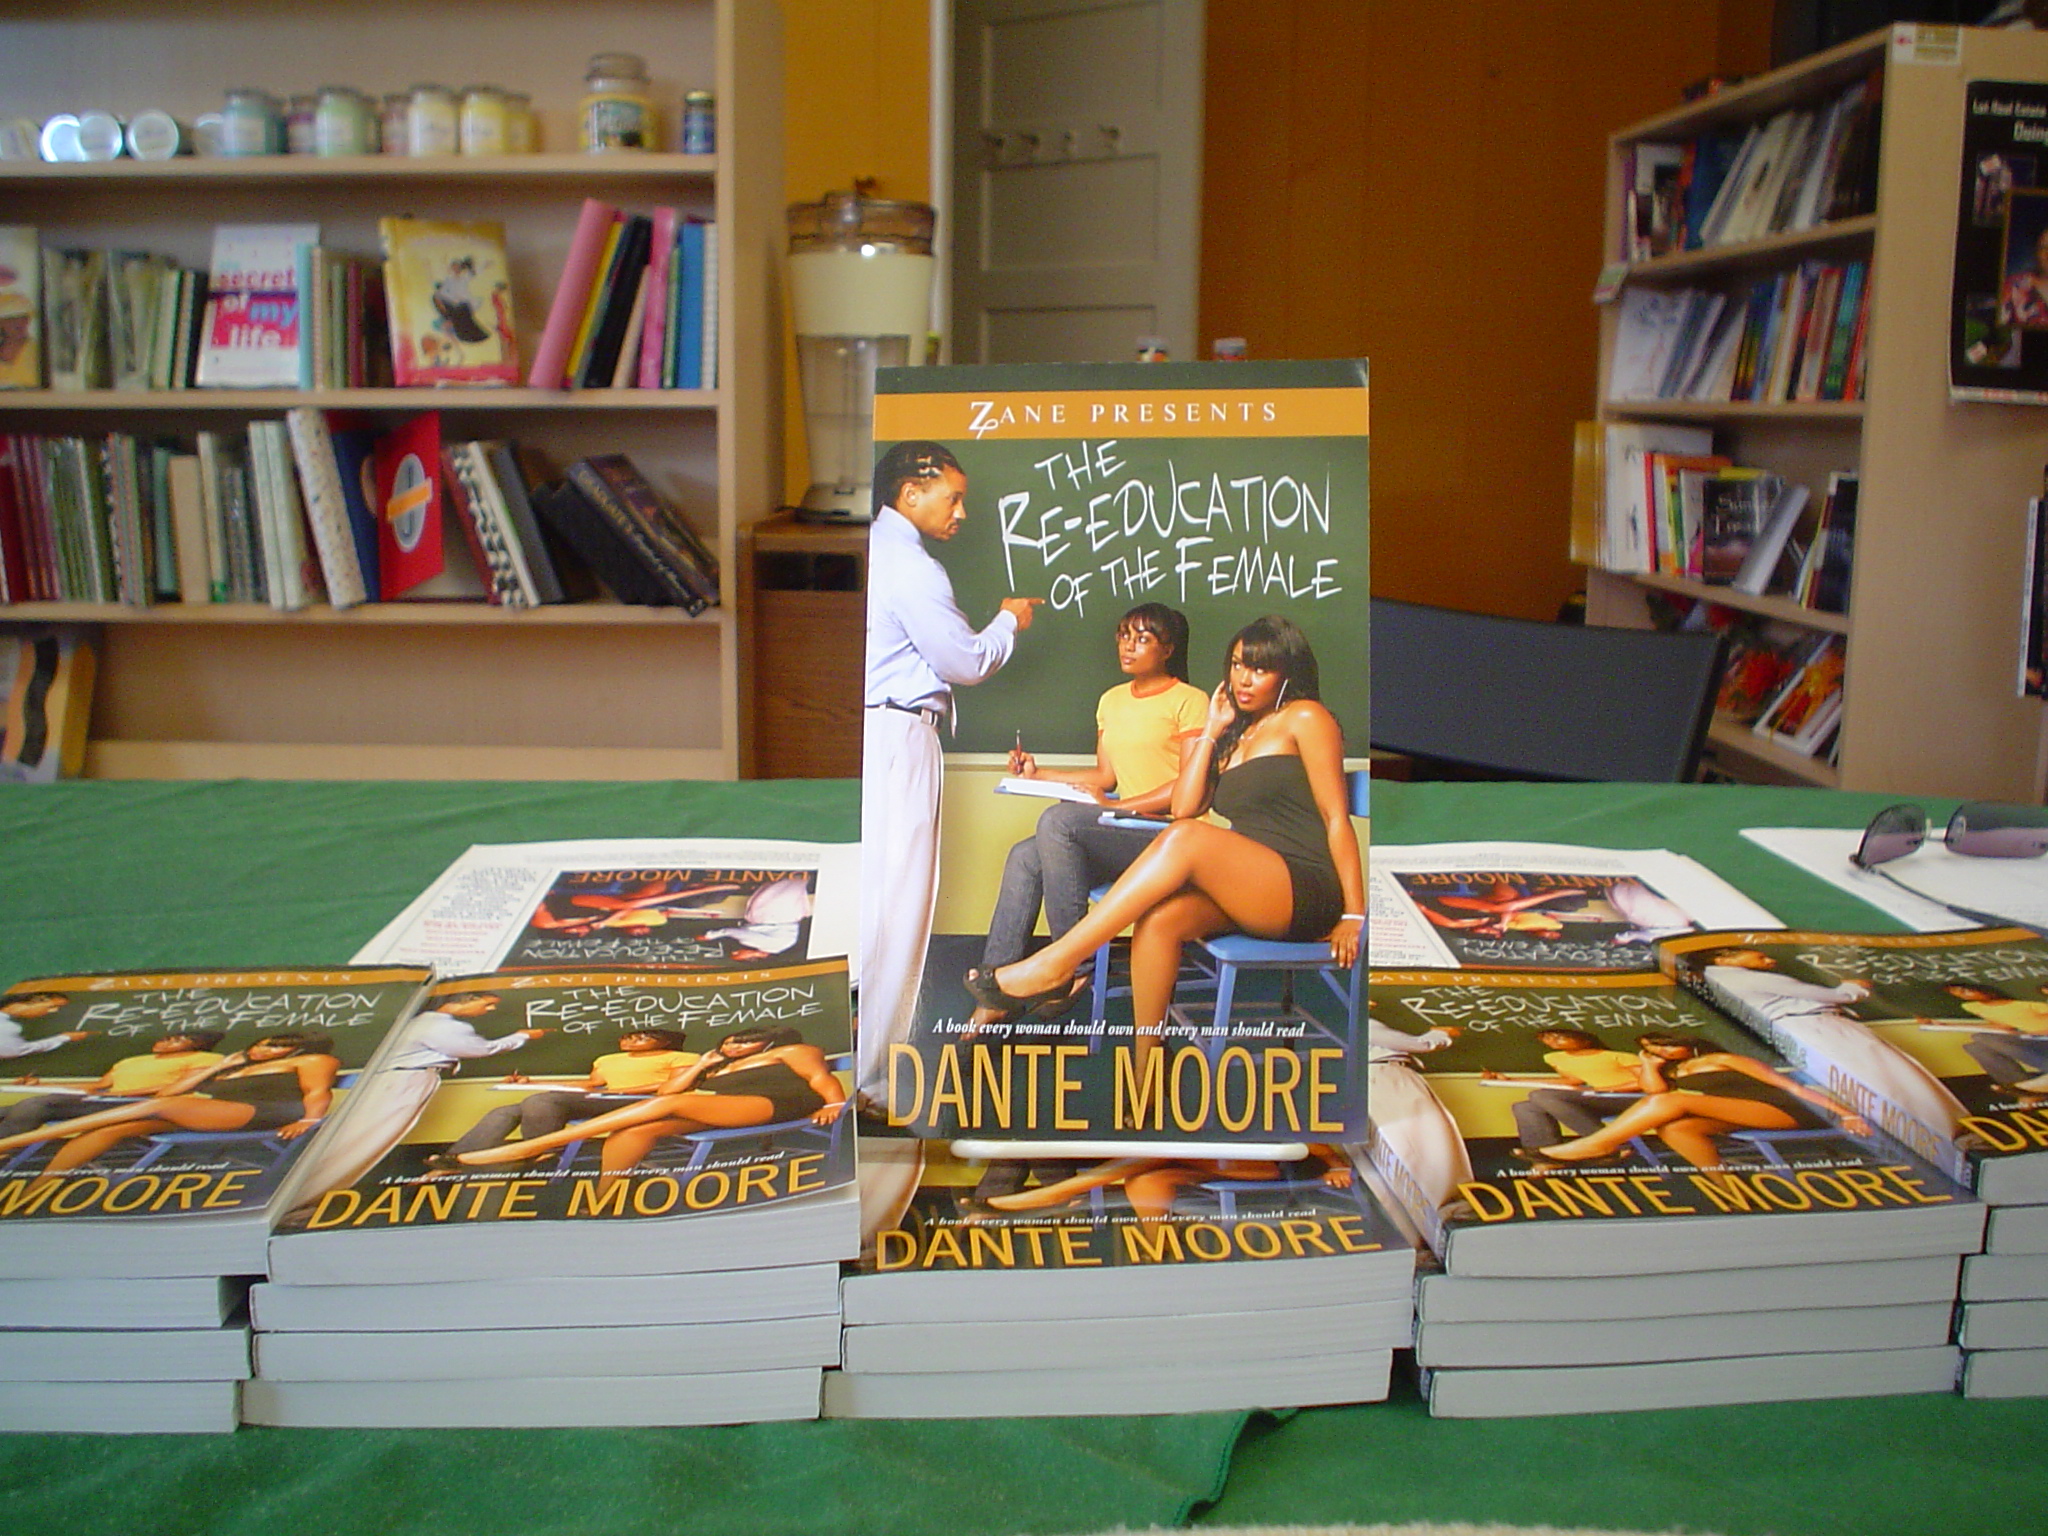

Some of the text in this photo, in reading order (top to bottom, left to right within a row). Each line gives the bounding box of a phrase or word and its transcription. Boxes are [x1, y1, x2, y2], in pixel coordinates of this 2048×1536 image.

[250, 300, 298, 328] my
[229, 323, 281, 348] life
[1091, 402, 1278, 424] PRESENTS
[1034, 440, 1127, 491] THE
[998, 460, 1331, 593] RE-EDUCATION
[1050, 537, 1343, 618] OF THE FEMALE
[570, 869, 811, 883] DANTE MOORE
[1410, 872, 1526, 886] MOORE
[134, 988, 213, 1004] THE
[526, 984, 815, 1028] RE-EDUCATION
[563, 985, 643, 1000] THE
[1421, 985, 1495, 999] THE
[76, 991, 383, 1031] RE-EDUCATION
[108, 1010, 376, 1037] OF THE FEMALE
[563, 1002, 823, 1034] OF THE FEMALE
[1400, 992, 1677, 1025] RE-EDUCATION
[1468, 1009, 1705, 1033] OF THE FEMALE
[932, 1018, 1306, 1041] A book every woman should own and every man should read
[888, 1043, 1345, 1133] DANTE MOORE
[1828, 1064, 1942, 1162] DANTE MOORE
[147, 1163, 195, 1173] should
[431, 1174, 467, 1183] every
[470, 1172, 520, 1180] woman
[523, 1169, 570, 1178] should
[603, 1168, 632, 1176] and
[633, 1167, 669, 1176] every
[673, 1164, 703, 1173] man
[705, 1157, 751, 1170] should
[753, 1151, 785, 1163] read
[1543, 1169, 1577, 1177] every
[1580, 1167, 1626, 1175] woman
[1629, 1165, 1669, 1173] should
[1793, 1160, 1834, 1168] should
[1835, 1158, 1863, 1166] read
[0, 1169, 263, 1216] MOORE
[307, 1154, 827, 1229] DANTE MOORE
[1457, 1174, 1696, 1225] DANTE
[1689, 1164, 1953, 1214] MOORE
[938, 1217, 970, 1226] book
[974, 1218, 1009, 1226] every
[1064, 1215, 1107, 1224] should
[1142, 1214, 1168, 1222] and
[1171, 1214, 1205, 1222] every
[1242, 1210, 1284, 1219] should
[1288, 1208, 1316, 1217] read
[876, 1226, 1102, 1271] DANTE
[1122, 1213, 1383, 1265] MOORE
